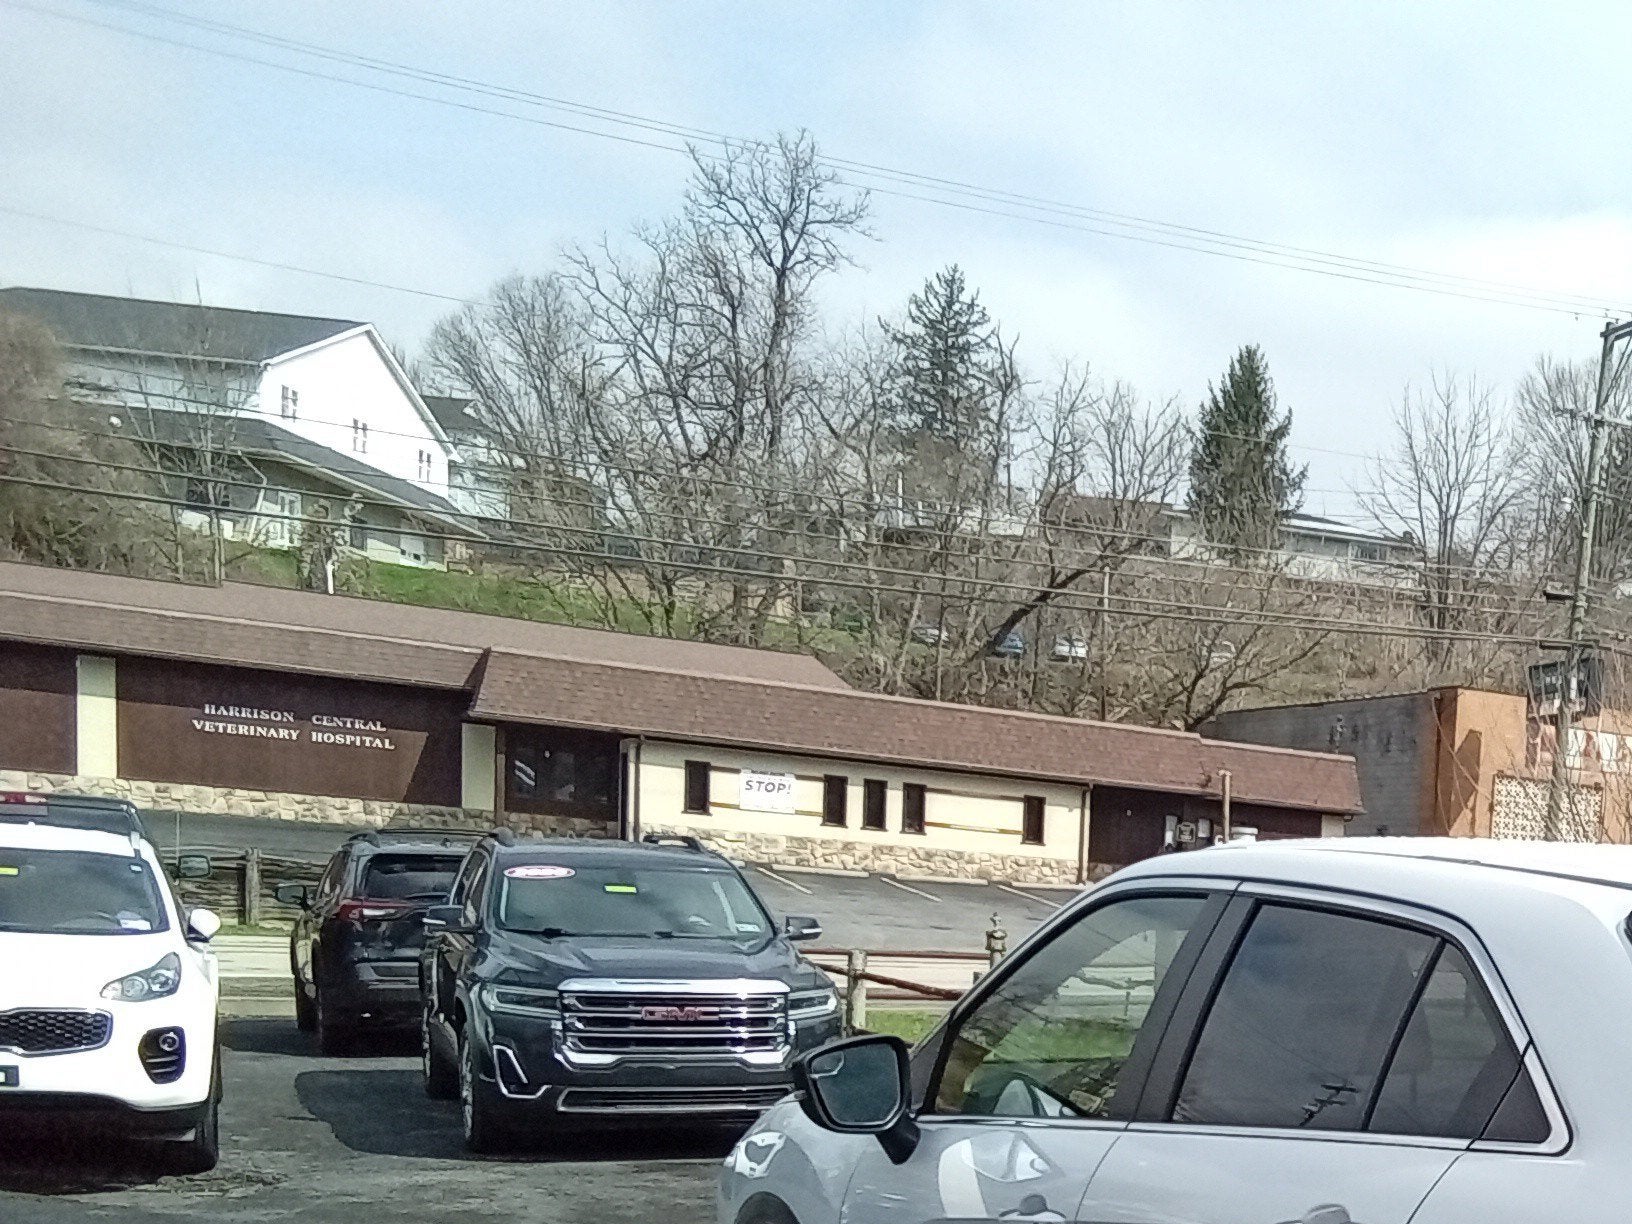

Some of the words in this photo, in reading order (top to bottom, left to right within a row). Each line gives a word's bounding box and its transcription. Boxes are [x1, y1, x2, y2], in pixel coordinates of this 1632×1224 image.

[204, 703, 294, 722] HARRISON
[311, 714, 386, 731] CENTRAL
[191, 719, 299, 740] VETERINARY
[311, 731, 395, 749] HOSPITAL
[745, 780, 791, 794] STOP!
